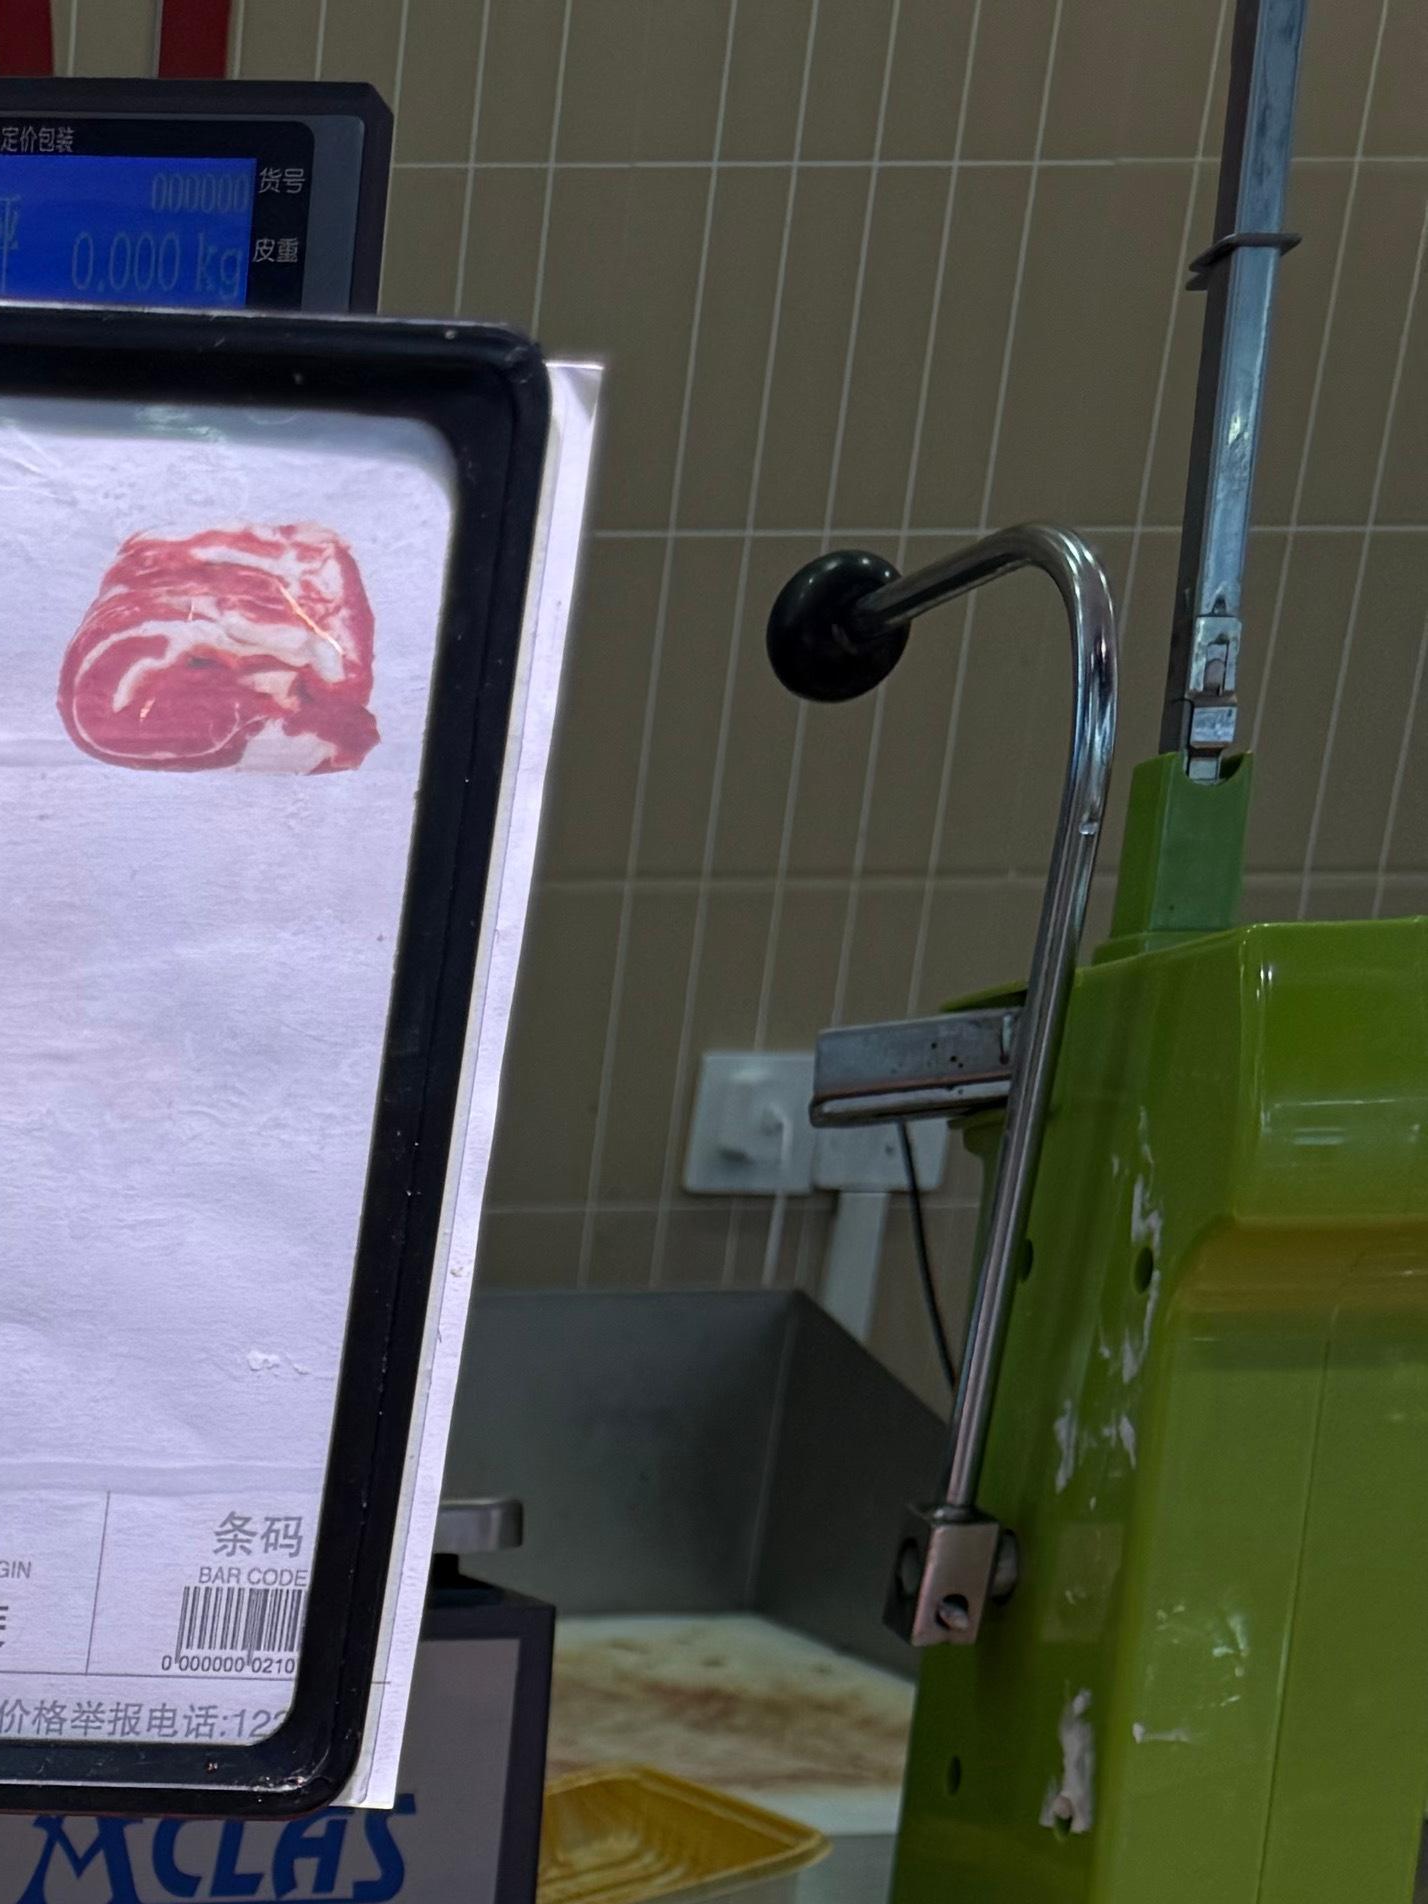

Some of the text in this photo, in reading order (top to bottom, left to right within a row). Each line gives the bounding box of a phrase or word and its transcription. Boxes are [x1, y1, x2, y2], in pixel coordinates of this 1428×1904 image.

[0, 126, 73, 154] 定价包装
[258, 167, 306, 194] 货号
[252, 238, 298, 263] 皮重
[212, 1510, 304, 1559] 条码
[198, 1567, 309, 1587] BAR CODE
